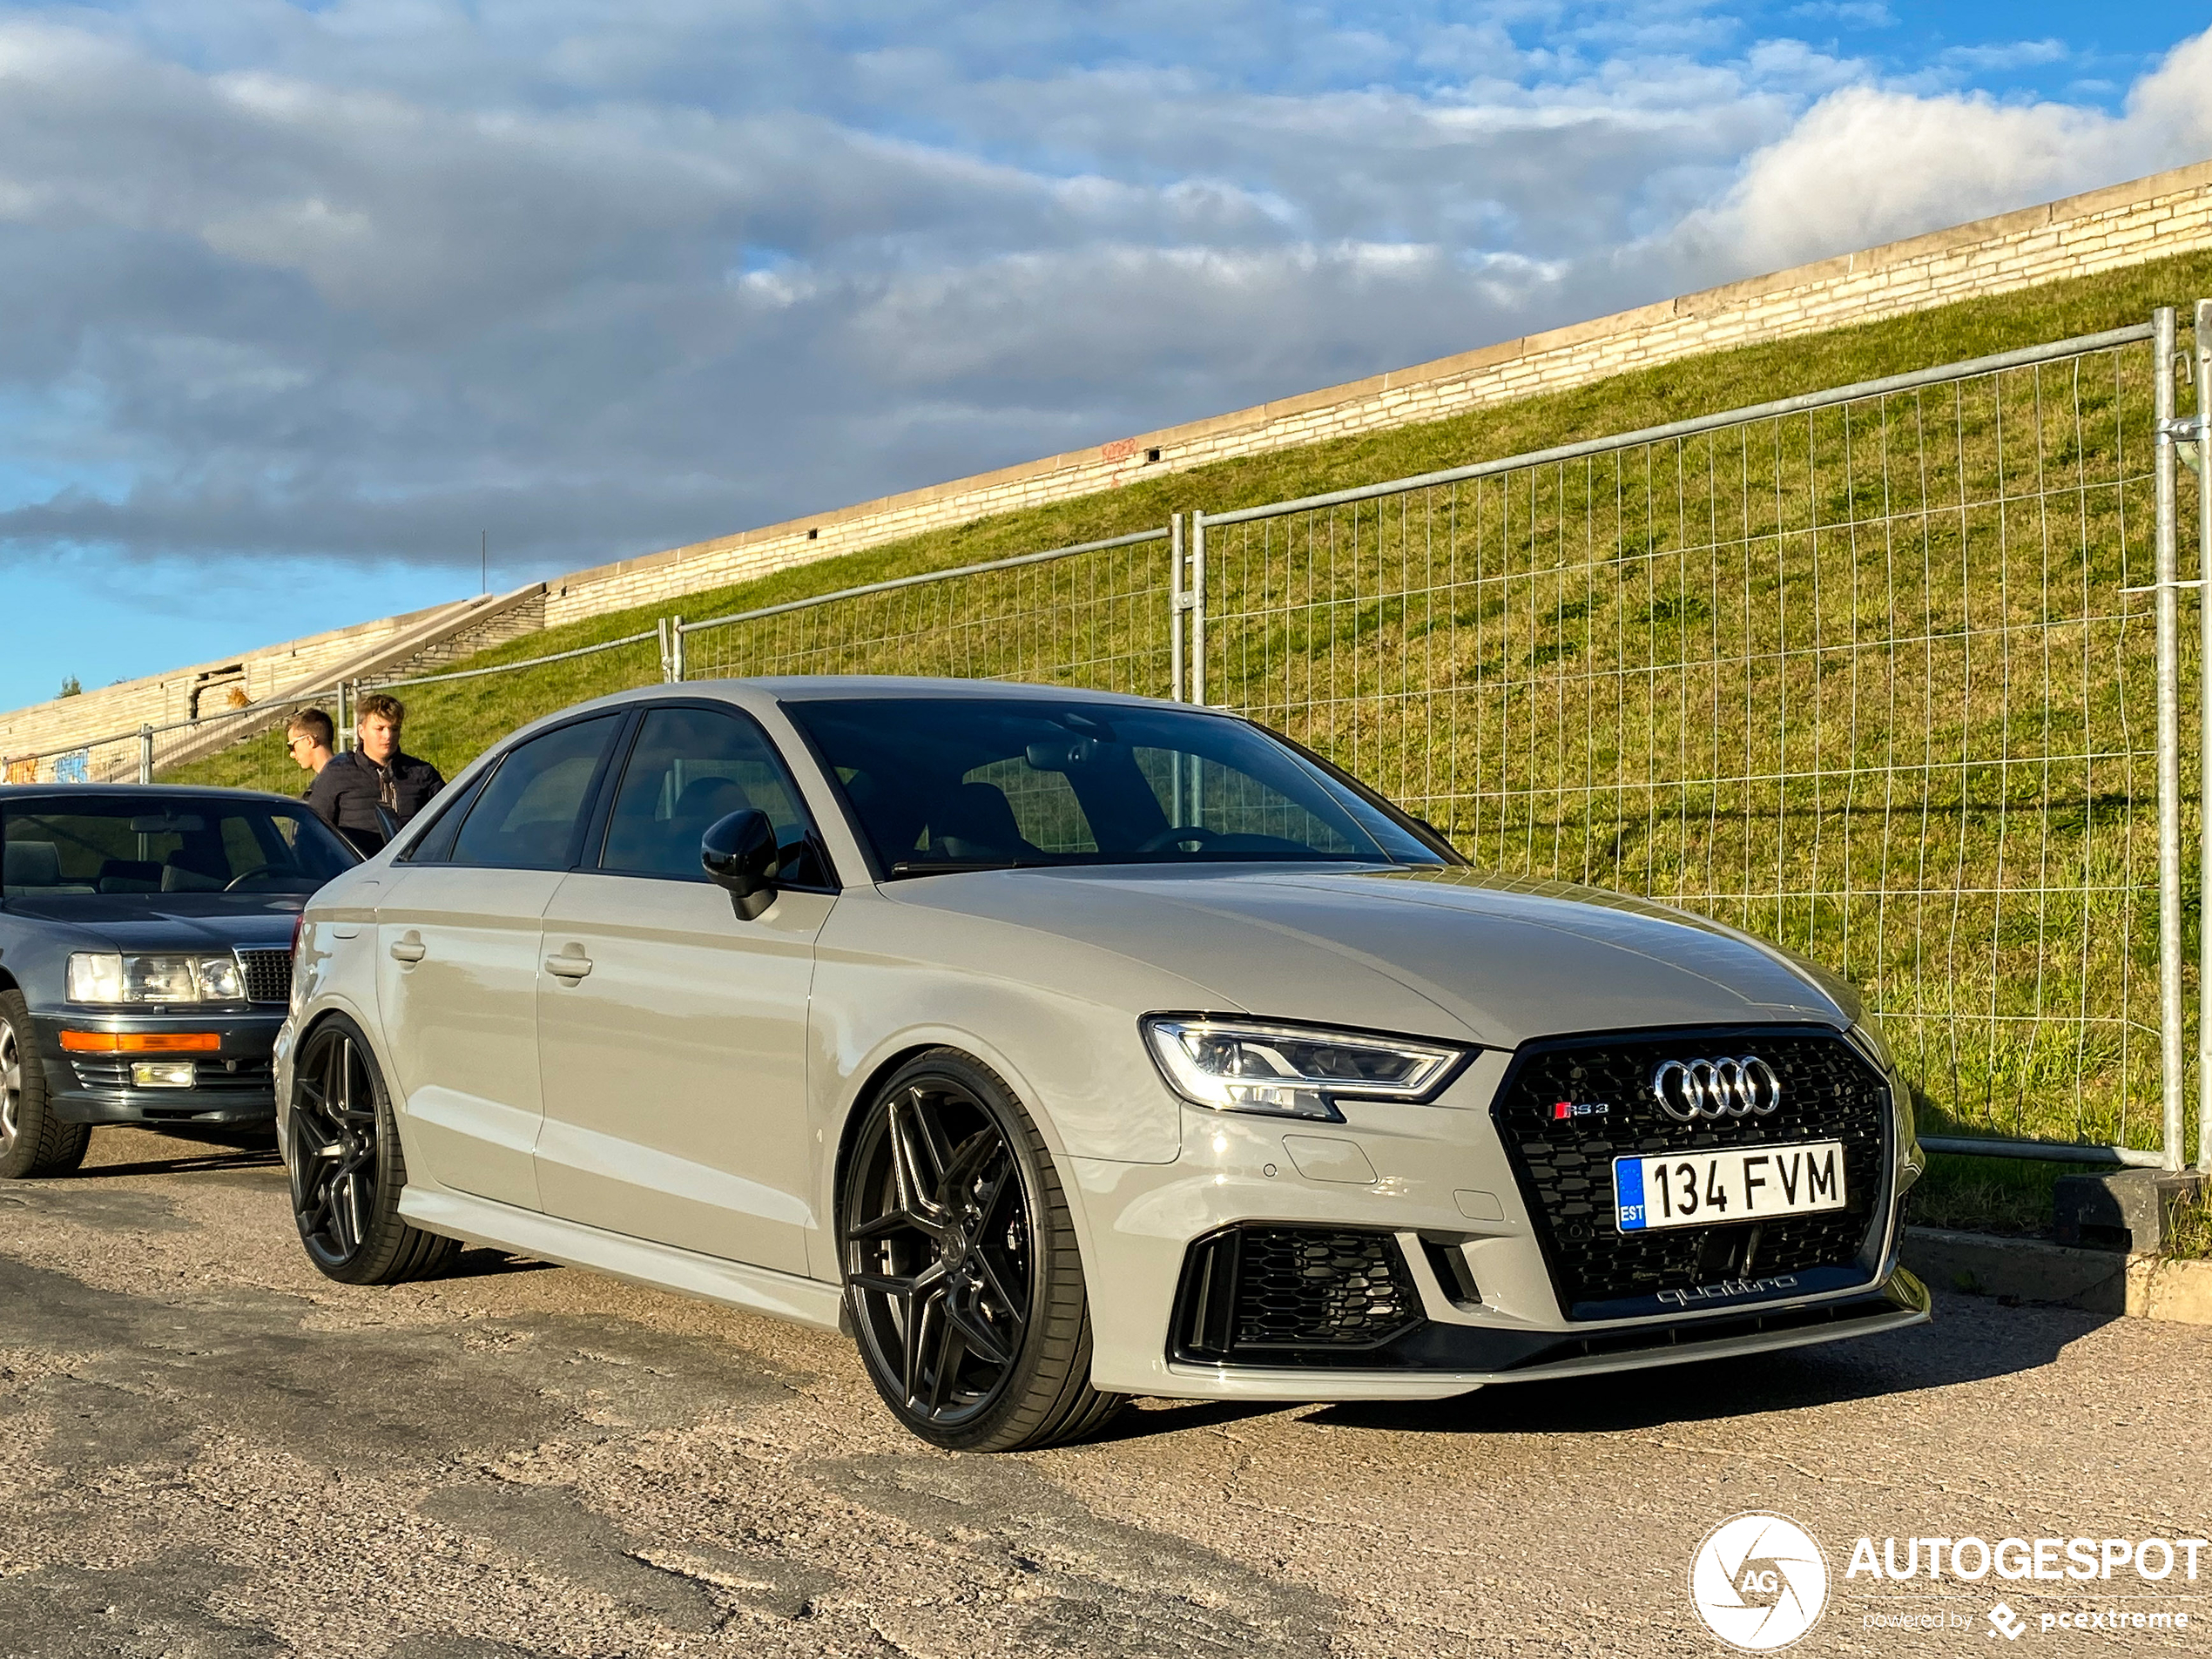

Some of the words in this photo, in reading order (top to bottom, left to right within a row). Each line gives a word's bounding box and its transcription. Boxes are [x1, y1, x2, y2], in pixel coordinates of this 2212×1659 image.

[1562, 1103, 1592, 1117] RS
[1595, 1103, 1609, 1114] 3
[1655, 1160, 1727, 1217] 134
[1743, 1150, 1837, 1210] FVM
[1620, 1204, 1644, 1222] EST
[1657, 1275, 1798, 1306] quattro
